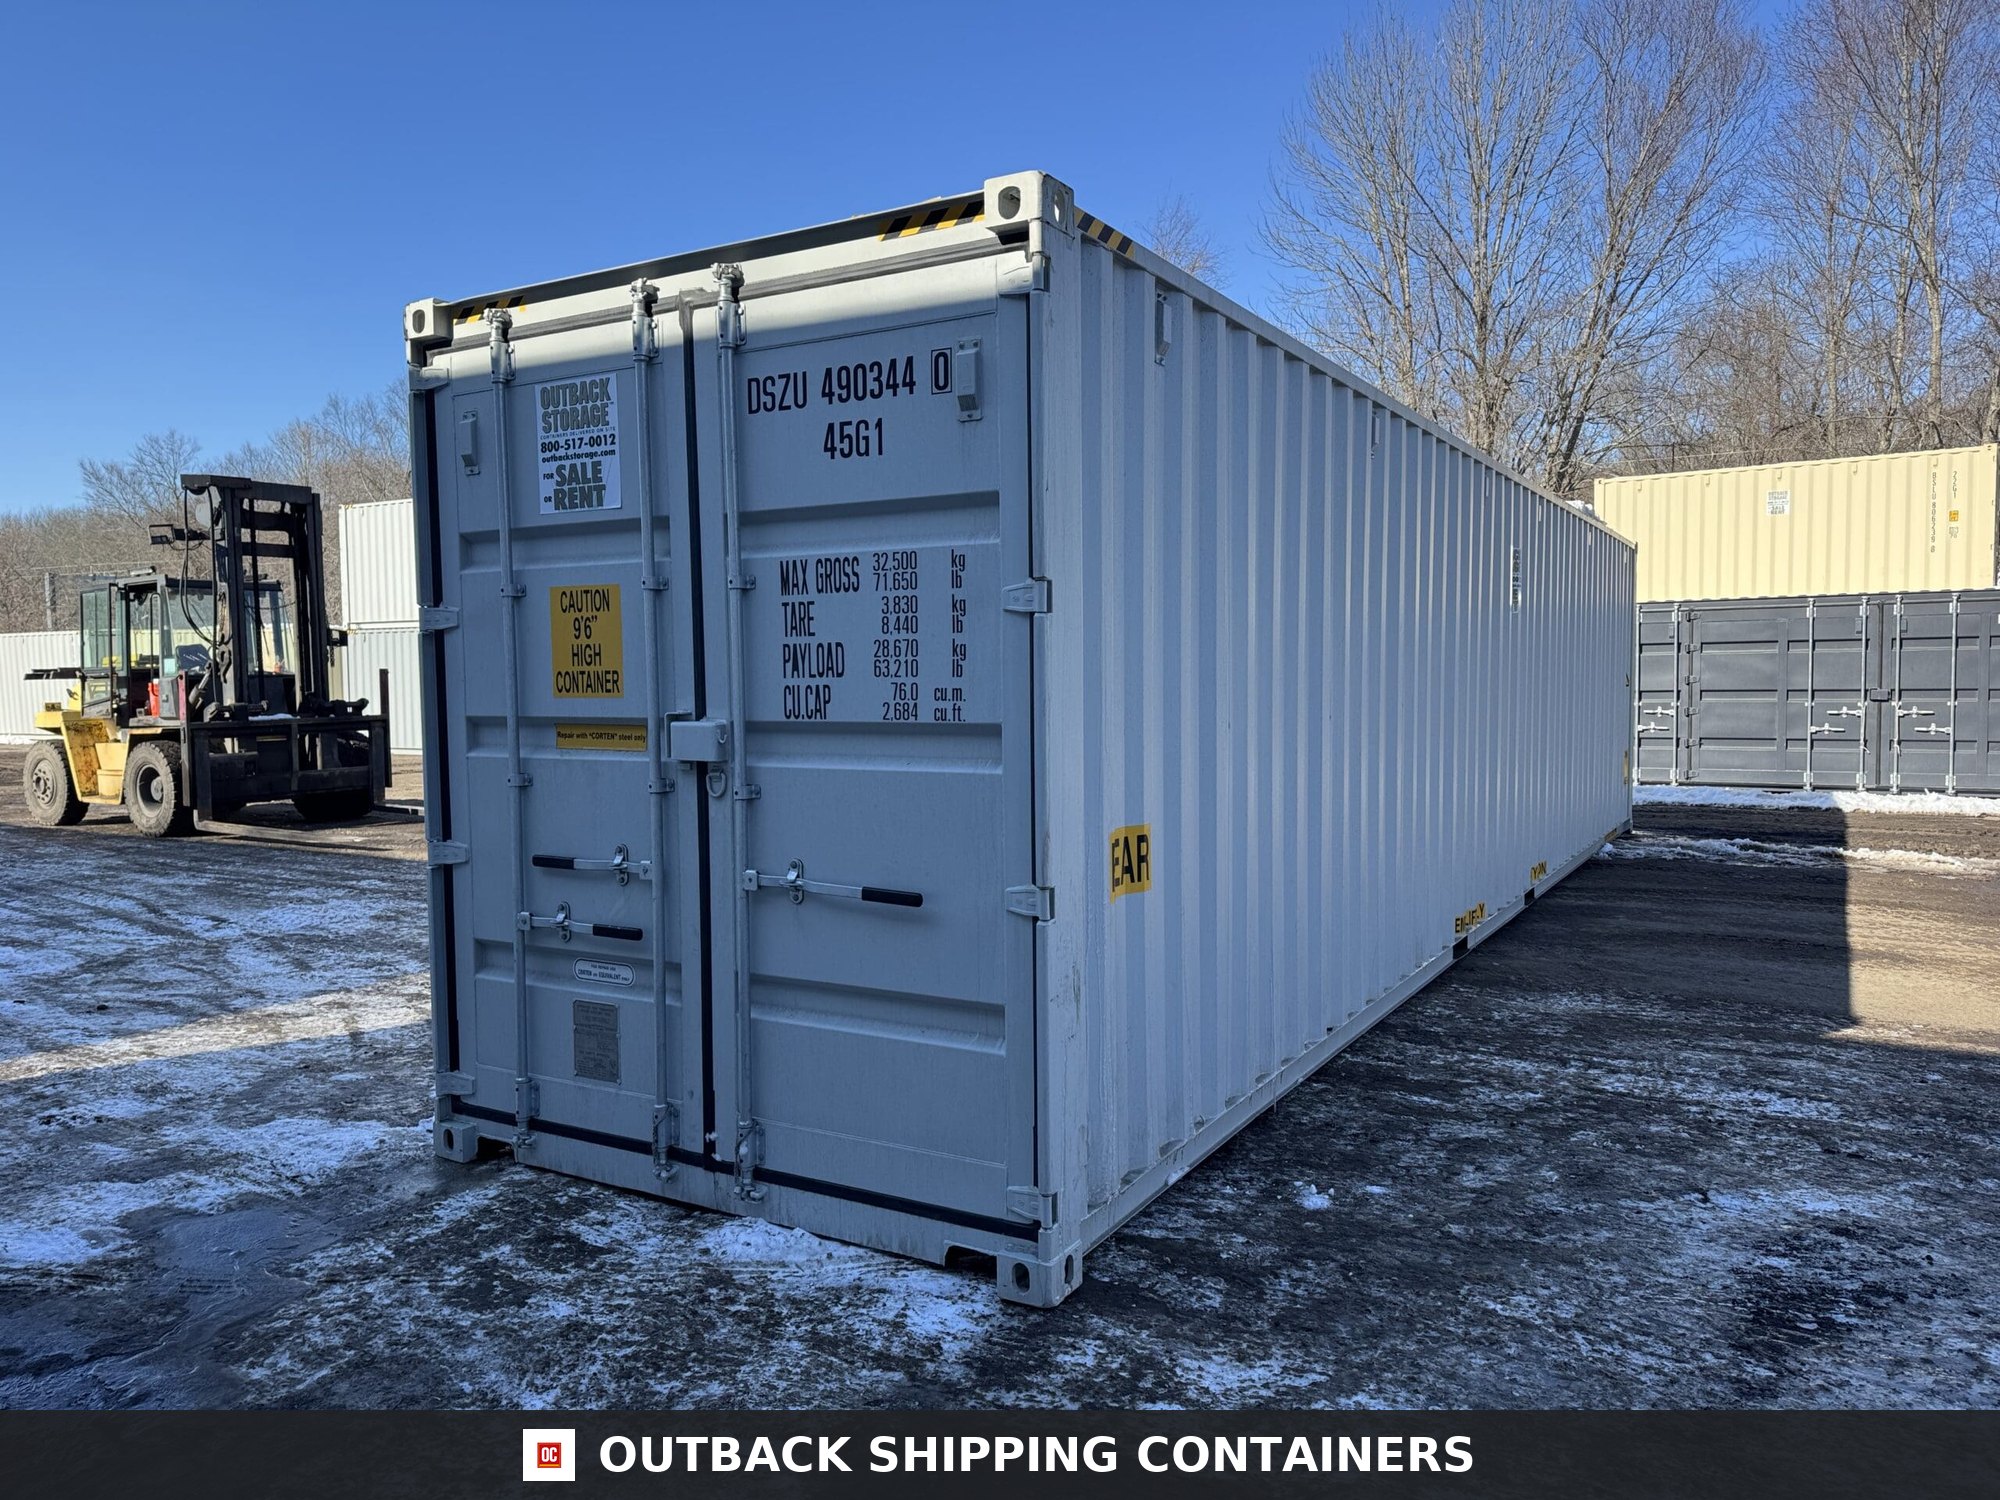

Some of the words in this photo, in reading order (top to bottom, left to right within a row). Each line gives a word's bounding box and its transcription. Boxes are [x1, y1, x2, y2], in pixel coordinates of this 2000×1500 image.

[540, 377, 611, 410] OUTBACK
[748, 371, 807, 414] DSZU
[821, 356, 916, 405] 490344
[933, 351, 950, 391] 0
[542, 402, 609, 434] STORAGE
[540, 432, 568, 440] CONTAINERS
[569, 428, 595, 437] DELIVERED
[541, 434, 616, 453] 800-517-0012
[824, 417, 883, 460] 45G1
[541, 448, 616, 463] outbackstorage.com
[543, 472, 554, 480] FOR
[555, 460, 603, 487] SALE
[544, 495, 552, 503] OR
[553, 484, 607, 511] RENT
[779, 559, 809, 596] MAX
[815, 556, 860, 594] GROSS
[951, 549, 965, 572] kg
[951, 569, 962, 589] lb
[560, 589, 610, 614] CAUTION
[781, 601, 815, 637] TARE
[952, 594, 966, 617] kg
[952, 614, 963, 633] lb
[571, 643, 602, 667] HIGH
[782, 642, 845, 679] PAYLOAD
[952, 638, 966, 661] kg
[952, 659, 963, 678] lb
[556, 670, 620, 694] CONTAINER
[783, 684, 831, 720] CU.CAP
[891, 682, 918, 701] 76.0
[934, 686, 966, 701] cu.m.
[934, 704, 966, 722] cu.ft.
[557, 731, 574, 740] Repair
[618, 733, 633, 741] steel
[634, 734, 646, 743] only
